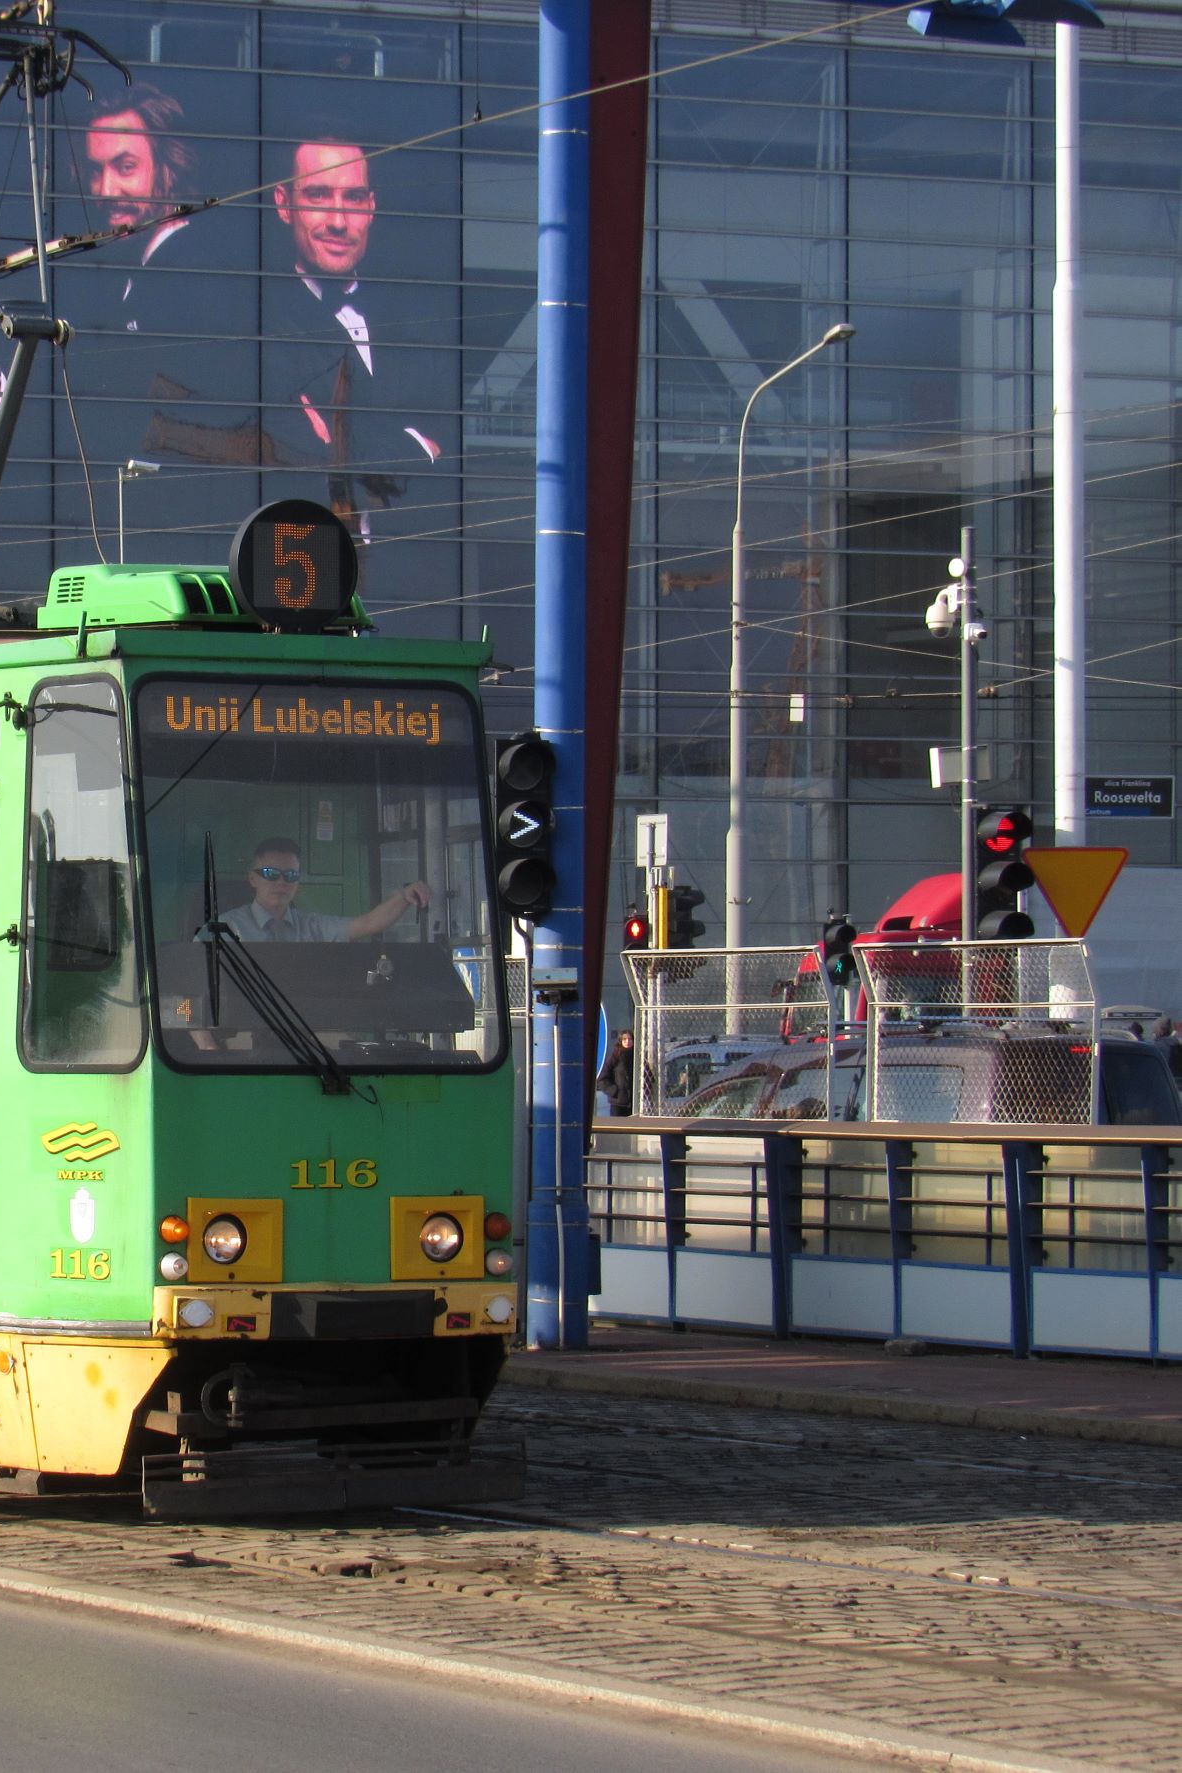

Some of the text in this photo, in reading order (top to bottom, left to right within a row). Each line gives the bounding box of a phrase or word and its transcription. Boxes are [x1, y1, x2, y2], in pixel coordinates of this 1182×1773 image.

[274, 522, 316, 609] 5
[166, 696, 440, 745] Unii Lubelskiej
[1094, 790, 1161, 803] Roosevelta
[176, 999, 192, 1022] 4
[58, 1169, 104, 1181] MPK
[290, 1158, 378, 1189] 116
[50, 1247, 111, 1281] 116
